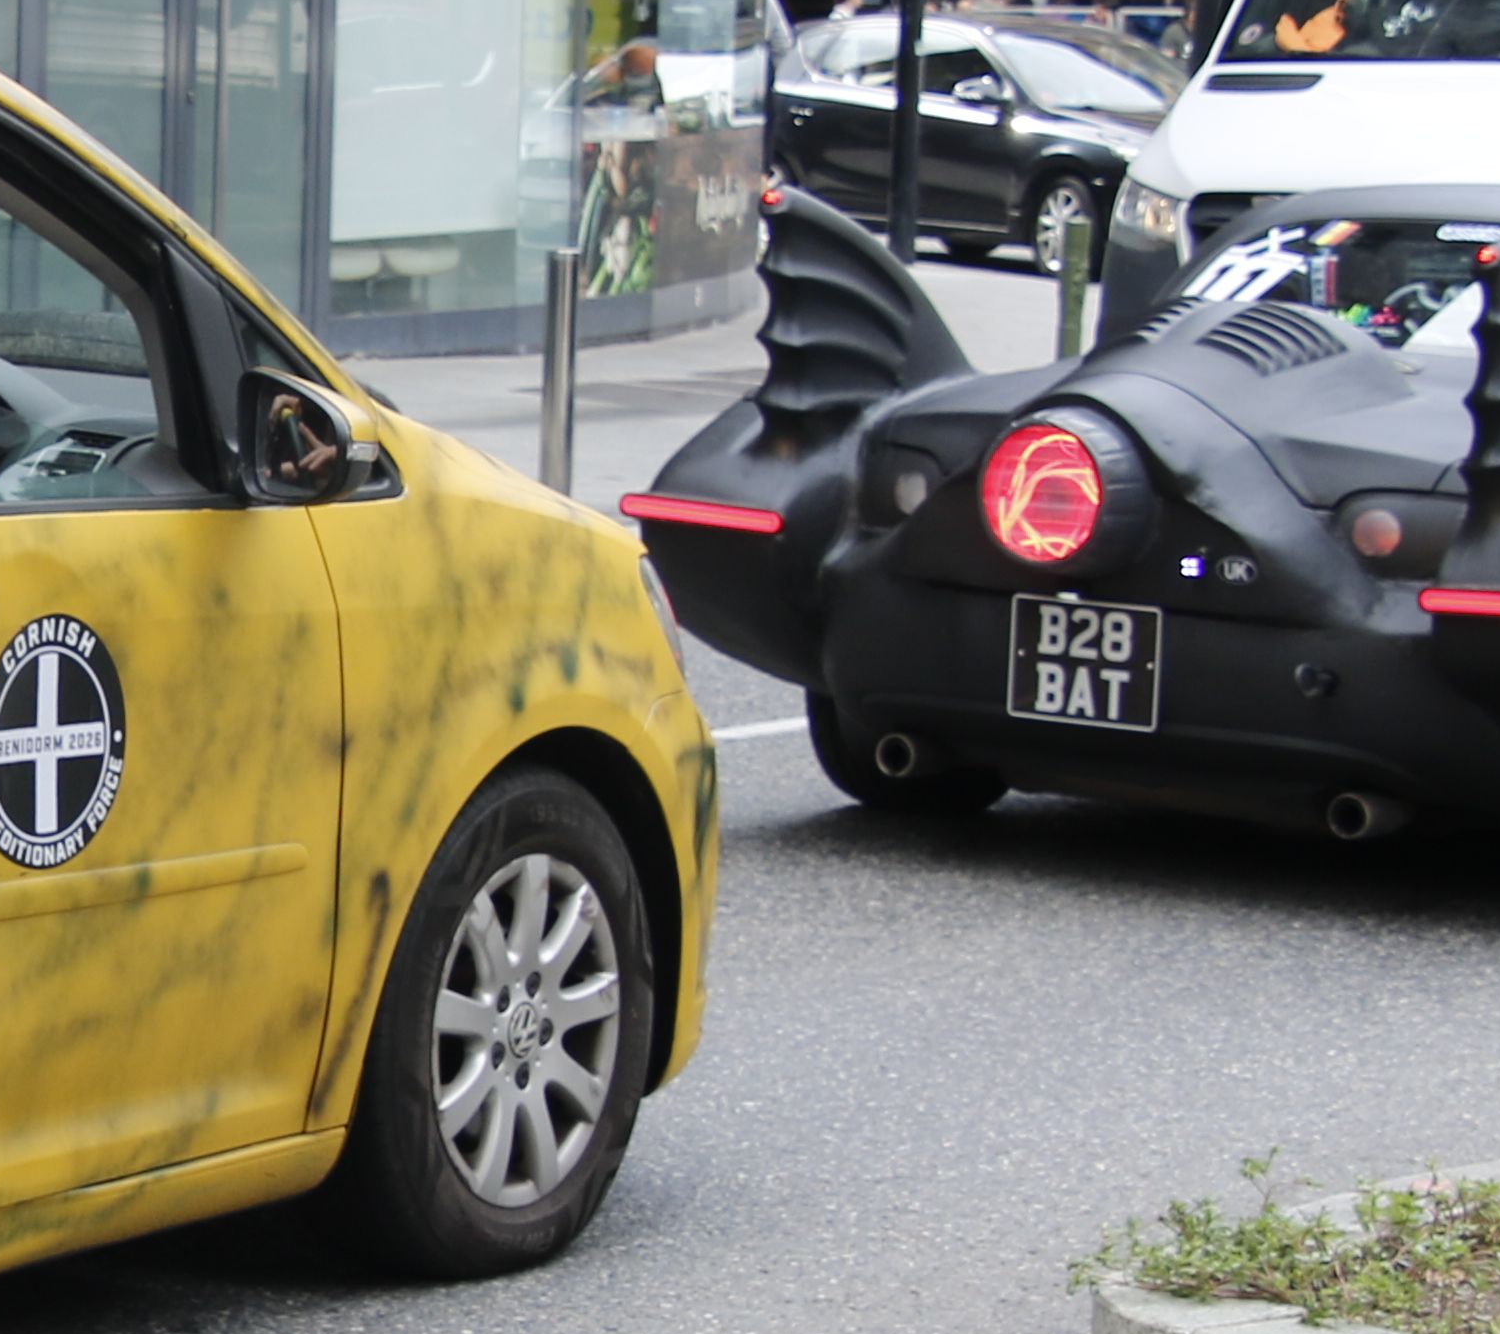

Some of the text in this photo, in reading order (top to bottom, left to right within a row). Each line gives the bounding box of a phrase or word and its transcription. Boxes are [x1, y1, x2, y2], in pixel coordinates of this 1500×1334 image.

[1223, 561, 1249, 582] UK
[1, 617, 97, 675] CORNISH
[1036, 603, 1134, 663] B28
[1034, 661, 1132, 721] BAT
[68, 729, 103, 751] 2026
[86, 756, 124, 834] FORCE
